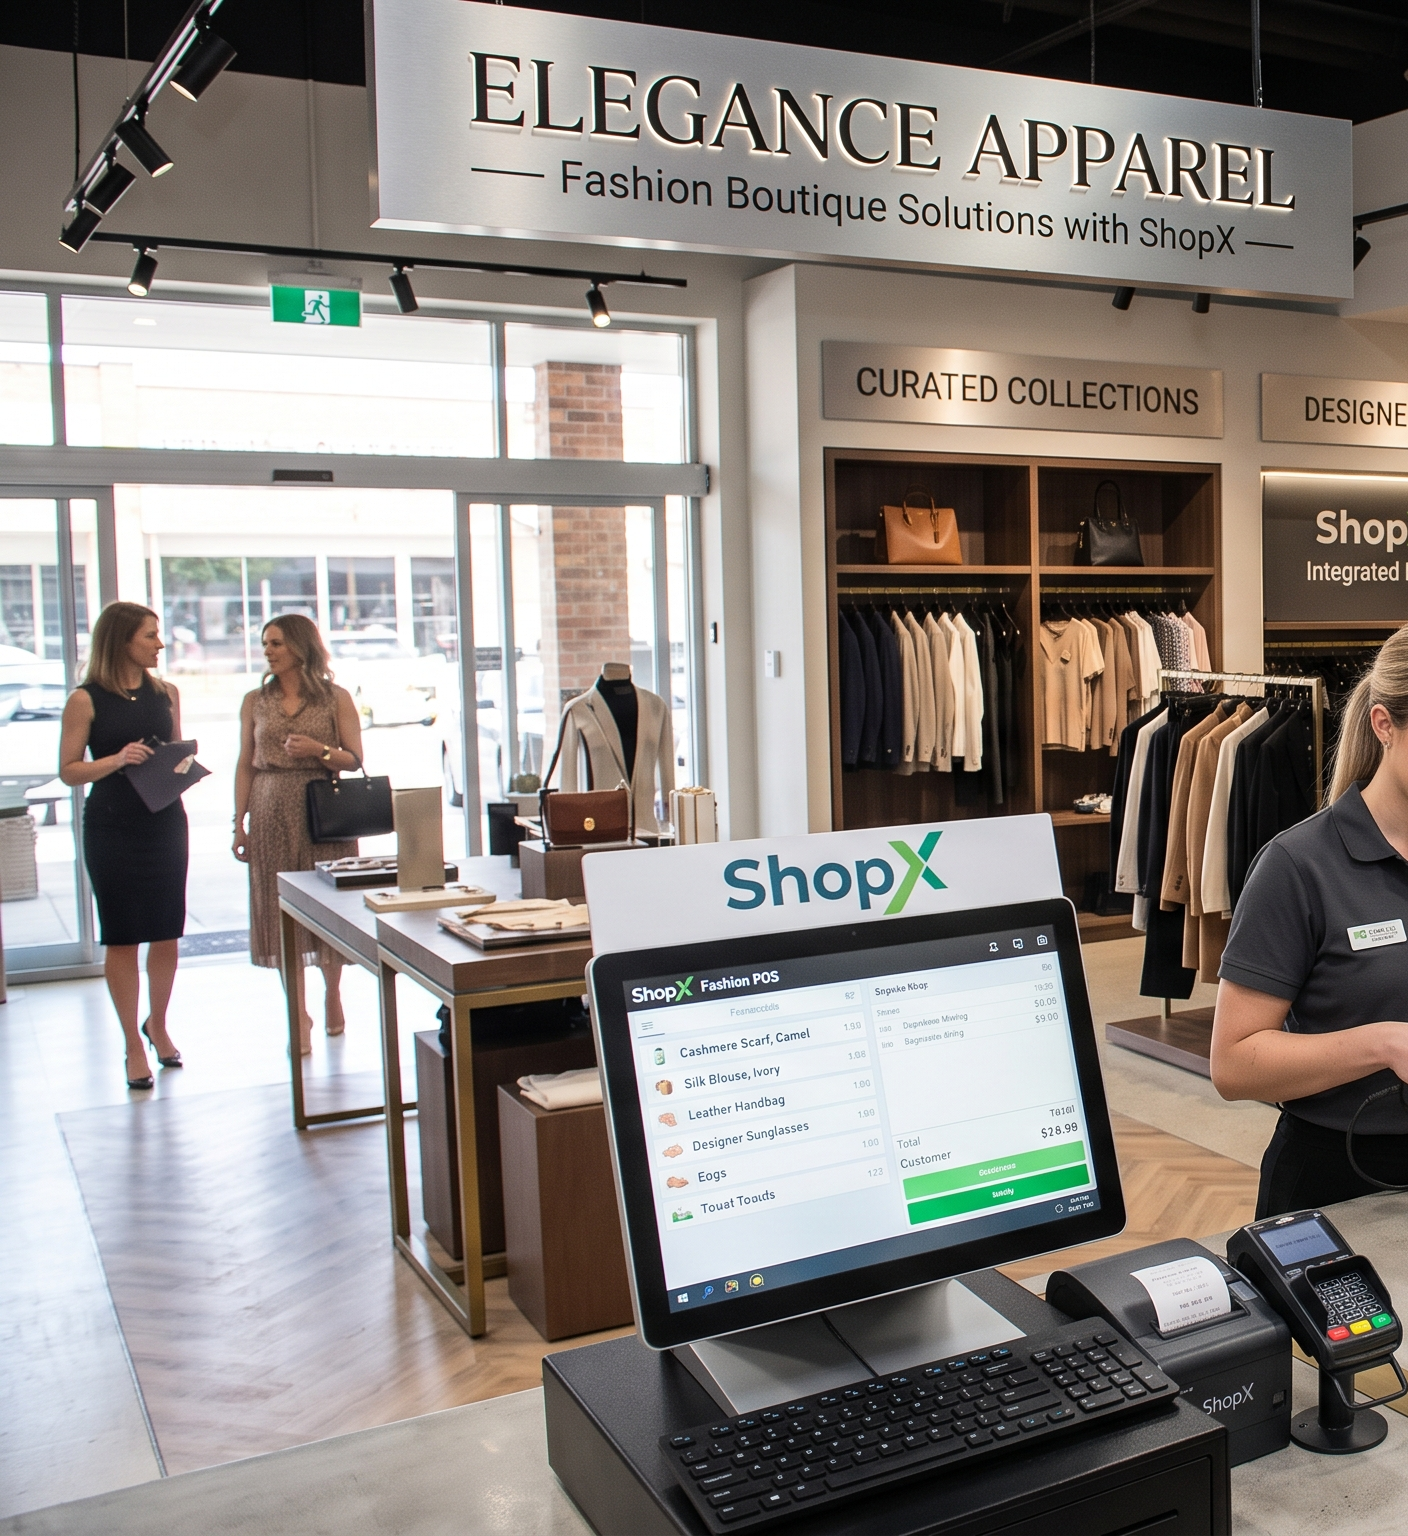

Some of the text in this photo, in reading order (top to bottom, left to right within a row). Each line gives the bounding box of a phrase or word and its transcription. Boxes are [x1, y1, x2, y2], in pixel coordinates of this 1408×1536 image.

[470, 51, 1295, 210] ELEGANCE APPAREL
[561, 160, 1235, 258] Fashion Boutique Solutions with ShopX
[856, 366, 1199, 415] CURATED COLLECTIONS
[1306, 559, 1400, 587] Integrated
[723, 830, 948, 916] ShopX
[631, 970, 780, 1003] ShopX Fashion POS
[680, 1028, 811, 1058] Cashmere Scarf, Camel
[684, 1064, 781, 1089] Silk Blouse, Ivory
[688, 1095, 786, 1121] Leather Handbag
[692, 1121, 810, 1152] Designer Sunglasses
[896, 1136, 921, 1149] Total
[867, 1166, 884, 1178] 123
[900, 1151, 952, 1169] Customer
[1203, 1382, 1254, 1415] ShopX
